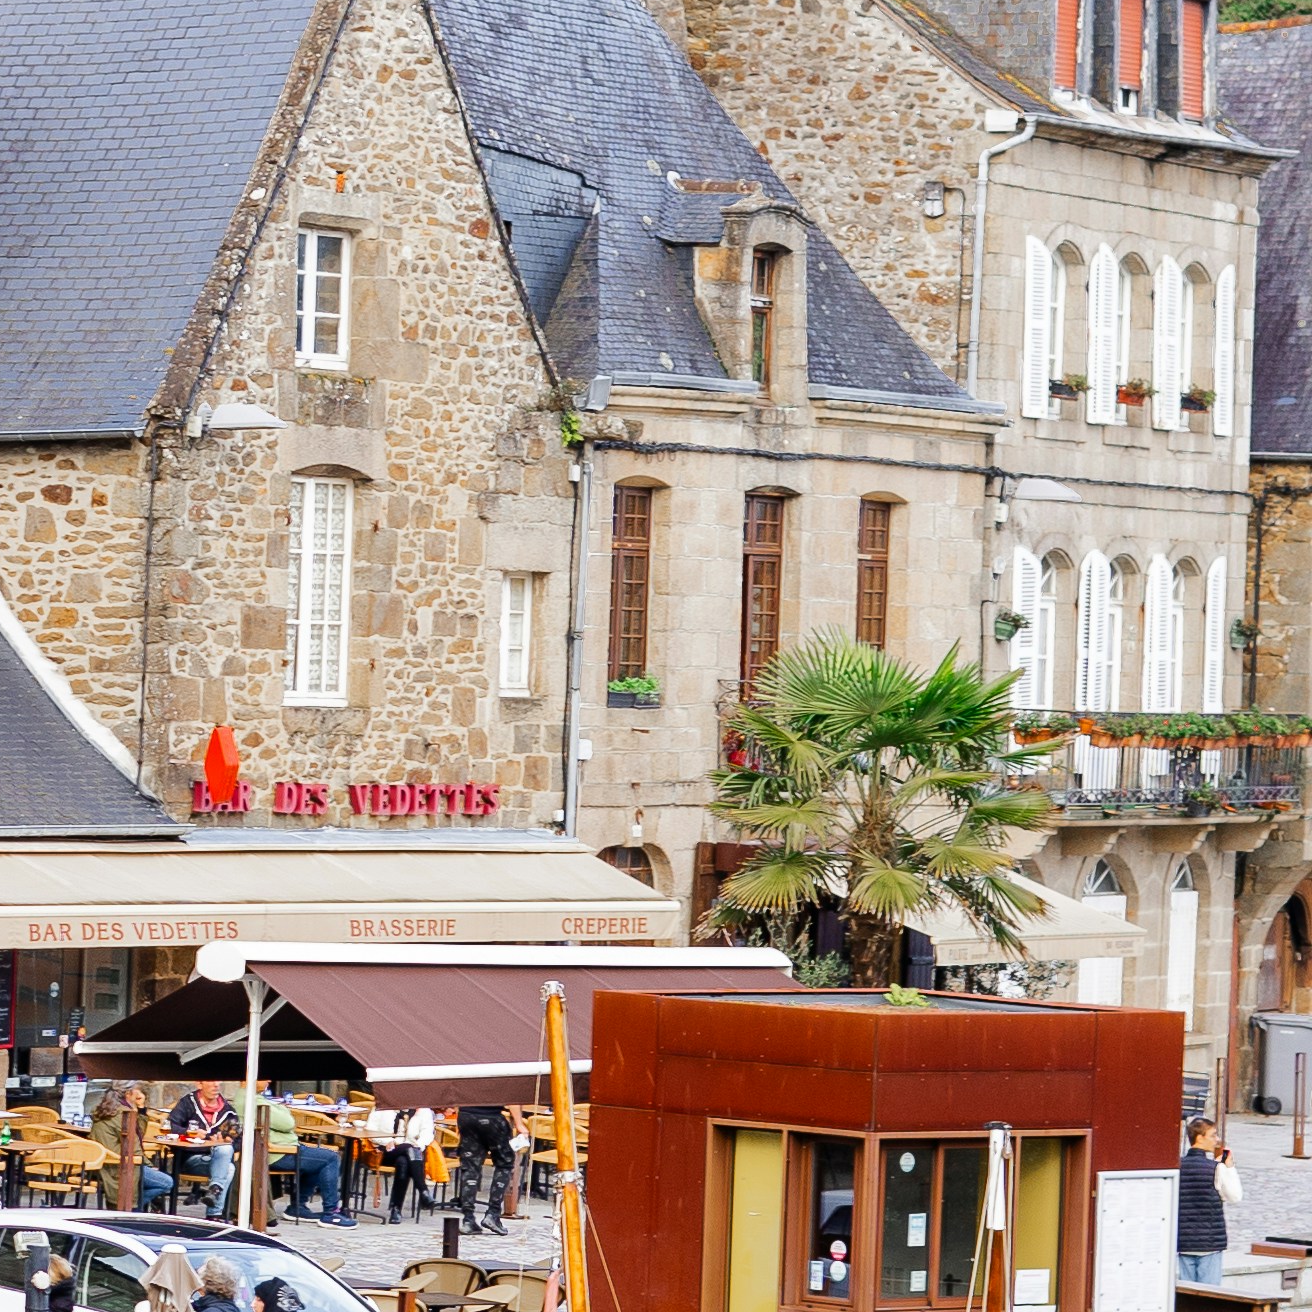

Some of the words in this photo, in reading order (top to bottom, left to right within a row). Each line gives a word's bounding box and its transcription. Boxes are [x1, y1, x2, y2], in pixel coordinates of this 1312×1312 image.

[192, 780, 251, 812] BR
[274, 781, 329, 815] DES
[348, 782, 501, 816] VEDETTES
[28, 923, 72, 943] BAR
[81, 922, 124, 941] DES
[131, 920, 239, 941] VEDETTES
[349, 918, 457, 938] BRASSERIE
[561, 916, 648, 935] CREPERIE
